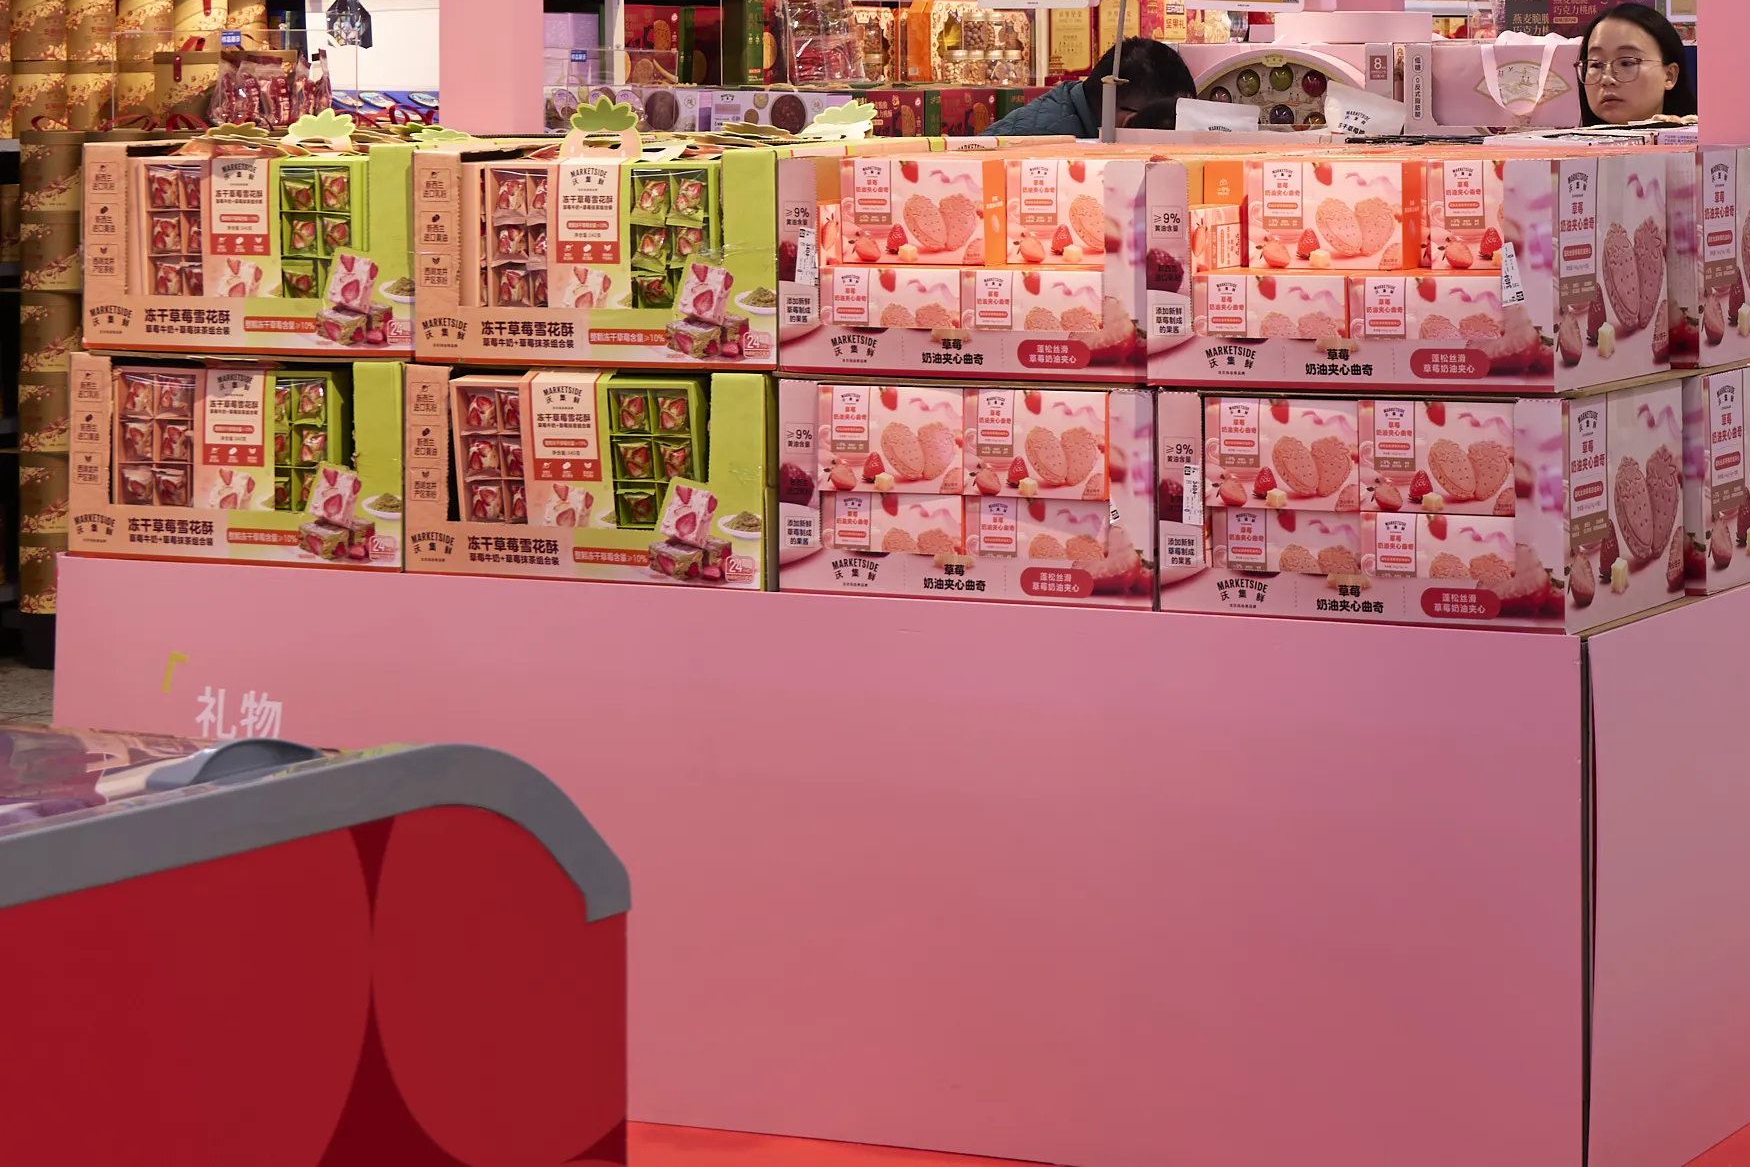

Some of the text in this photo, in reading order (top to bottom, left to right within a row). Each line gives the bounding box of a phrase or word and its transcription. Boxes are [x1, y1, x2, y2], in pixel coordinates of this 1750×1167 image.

[1553, 5, 1598, 15] 巧克力桃酥
[1166, 19, 1185, 29] 坚果礼
[570, 167, 608, 178] MARKETSIDE
[426, 182, 444, 190] 新西兰
[215, 190, 263, 198] 冻干草莓雪花酥
[423, 190, 447, 199] 进口乳粉
[1264, 189, 1301, 197] 奶油夹心曲奇
[1445, 189, 1484, 197] 奶油夹心曲奇
[1714, 191, 1725, 203] 草莓
[563, 196, 613, 204] 冻干草莓雪花酥
[1572, 202, 1584, 214] 草莓
[1704, 205, 1735, 220] 奶油夹心曲奇
[1154, 212, 1181, 225] ≥9%
[427, 225, 445, 233] 新西兰
[1560, 217, 1595, 233] 奶油夹心曲奇
[423, 233, 448, 242] 进口黄油
[90, 305, 133, 318] MARKETSIDE
[1156, 307, 1182, 315] 添加新鲜
[144, 309, 231, 325] 冻干草莓雪花酥
[1156, 317, 1183, 325] 草莓制成
[422, 317, 467, 331] MARKETSIDE
[481, 321, 574, 337] 冻干草莓雪花酥
[1159, 325, 1180, 333] 的果酱
[145, 325, 230, 335] 草莓牛奶+草莓抹茶组合装
[483, 338, 574, 348] 草莓牛奶+草莓抹茶组合装
[830, 334, 878, 349] MARKETSIDE
[941, 338, 963, 350] 草莓
[1036, 345, 1069, 353] 蓬松丝滑
[1205, 345, 1257, 362] MARKETSIDE
[1327, 348, 1350, 361] 草莓
[921, 352, 984, 366] 奶油夹心曲奇
[1029, 354, 1077, 364] 草莓奶油夹心
[1209, 356, 1254, 369] 沃集鲜
[1431, 354, 1466, 364] 蓬松丝滑
[1305, 363, 1374, 377] 奶油夹心曲奇
[1423, 363, 1475, 374] 草莓奶油夹心
[543, 386, 582, 396] MARKETSIDE
[416, 394, 434, 403] 新西兰
[210, 400, 259, 409] 冻干草莓雪花酥
[413, 403, 437, 412] 进口乳粉
[536, 413, 591, 422] 冻干草莓雪花酥
[1721, 413, 1732, 426] 草莓
[786, 429, 812, 440] ≥9%
[1221, 426, 1258, 436] 奶油夹心曲奇
[1712, 427, 1743, 445] 奶油夹心曲奇
[417, 438, 435, 446] 新西兰
[1582, 440, 1594, 453] 草莓
[413, 447, 438, 456] 进口黄油
[1165, 443, 1194, 455] ≥9%
[1166, 455, 1192, 463] 黄油含量
[1571, 453, 1605, 474] 奶油夹心曲奇
[74, 514, 115, 527] MARKETSIDE
[128, 518, 214, 535] 冻干草莓雪花酥
[411, 532, 455, 545] MARKETSIDE
[468, 535, 559, 553] 冻干草莓雪花酥
[1167, 538, 1194, 546] 添加新鲜
[1168, 547, 1195, 557] 草莓制成
[469, 553, 560, 565] 草莓牛奶+草莓抹茶组合装
[1171, 556, 1192, 566] 的果酱
[832, 558, 880, 572] MARKETSIDE
[944, 564, 965, 576] 草莓
[1039, 571, 1072, 582] 蓬松丝滑
[923, 577, 986, 592] 奶油夹心曲奇
[1032, 582, 1080, 593] 草莓奶油夹心
[1216, 578, 1269, 594] MARKETSIDE
[1338, 584, 1361, 597] 草莓
[1220, 590, 1265, 603] 沃集鲜
[1441, 592, 1477, 602] 蓬松丝滑
[1316, 598, 1385, 614] 奶油夹心曲奇
[1433, 602, 1485, 614] 草莓奶油夹心
[195, 685, 282, 740] 礼物
